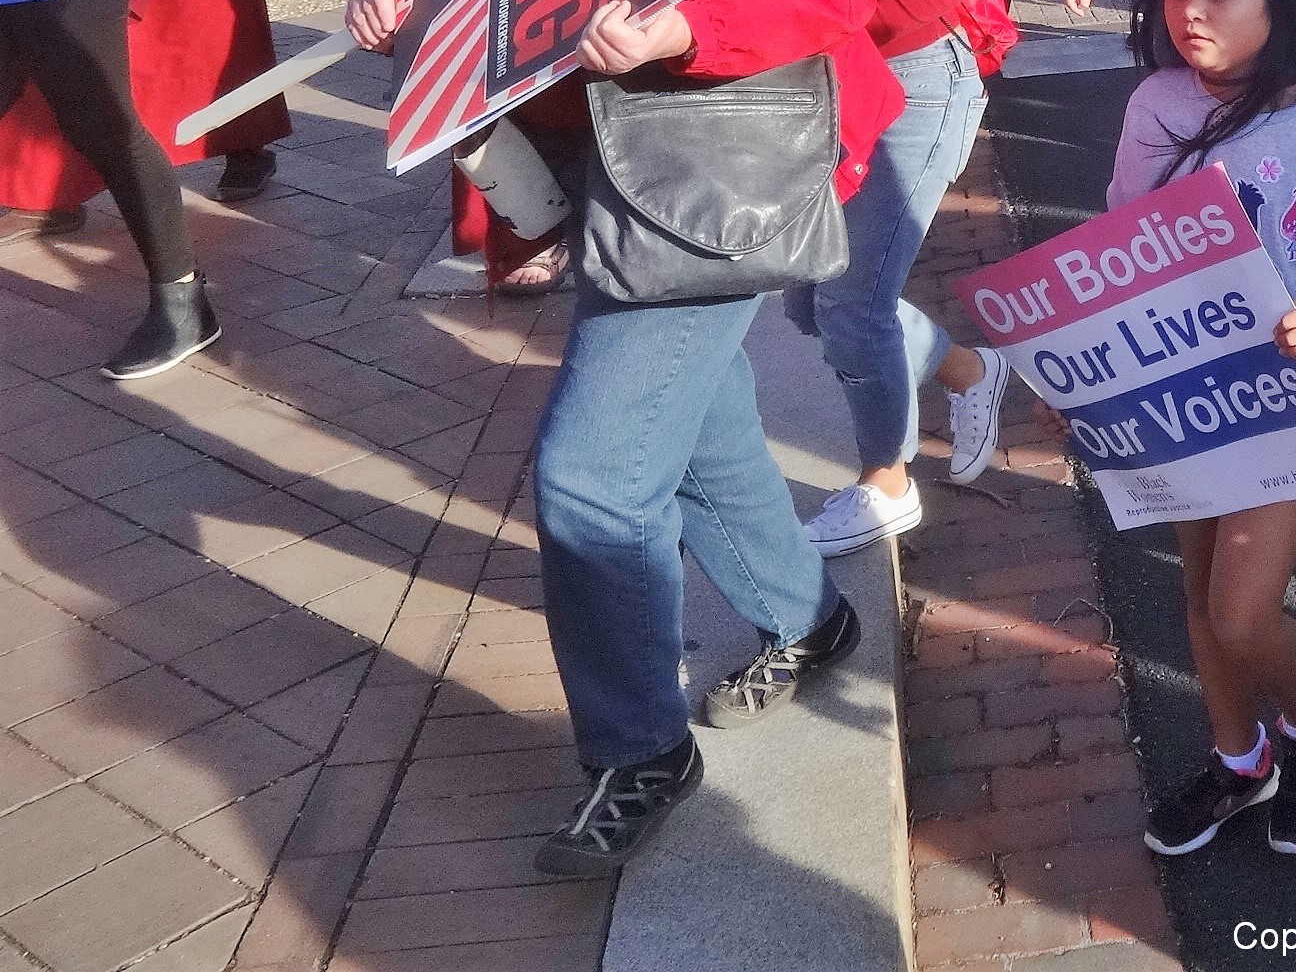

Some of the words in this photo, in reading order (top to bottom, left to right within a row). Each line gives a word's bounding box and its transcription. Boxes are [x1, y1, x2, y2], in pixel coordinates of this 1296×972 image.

[974, 277, 1056, 336] Our
[1055, 204, 1235, 305] Bodies
[1033, 339, 1118, 395] Our
[1117, 291, 1257, 369] Lives
[1070, 417, 1147, 460] Our
